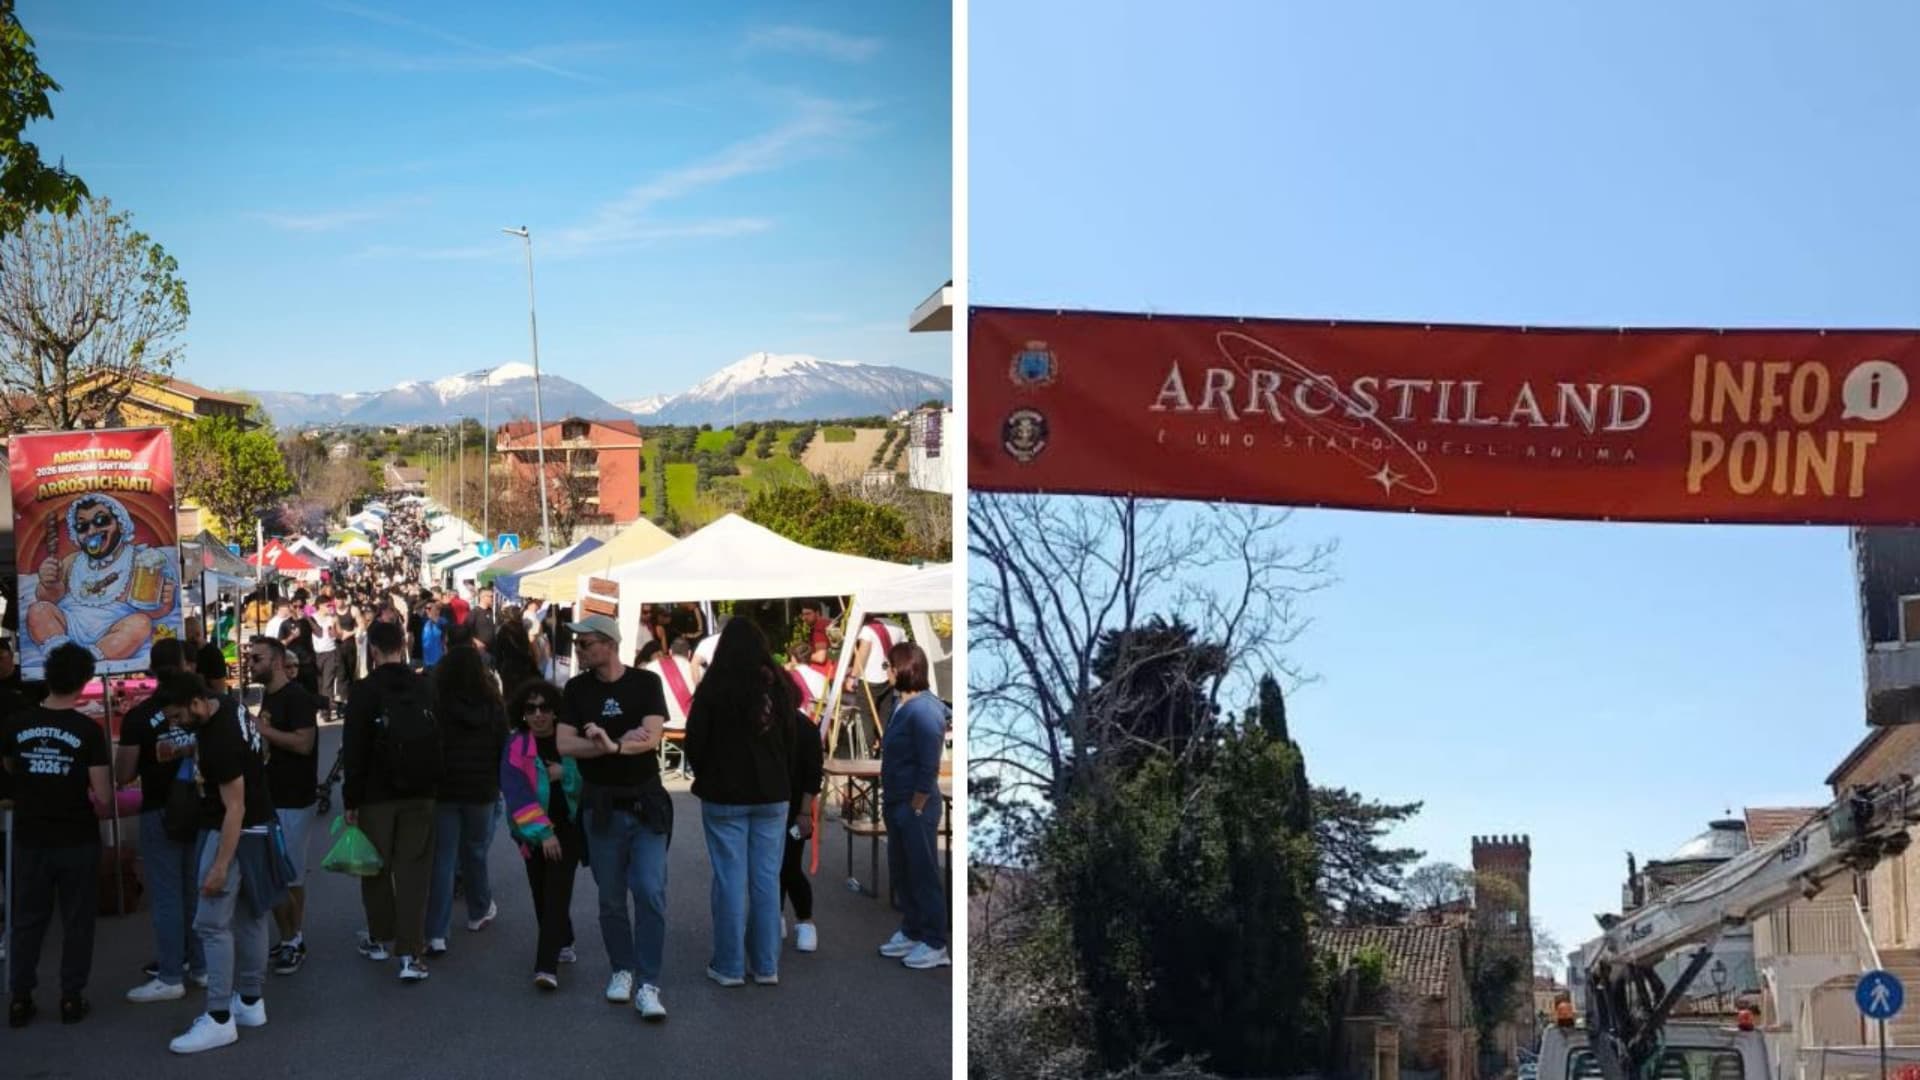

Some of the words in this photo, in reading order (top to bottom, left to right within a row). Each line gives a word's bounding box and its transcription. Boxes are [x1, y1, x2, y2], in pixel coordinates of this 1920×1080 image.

[1149, 360, 1652, 434] ARROSTILAND
[1690, 354, 1830, 424] INFO
[1196, 432, 1255, 447] UNO
[1283, 435, 1383, 450] STATO
[54, 448, 132, 463] ARROSTILAND
[1687, 431, 1877, 497] POINT
[16, 726, 81, 749] ARROSTILAND
[29, 759, 61, 775] 2026
